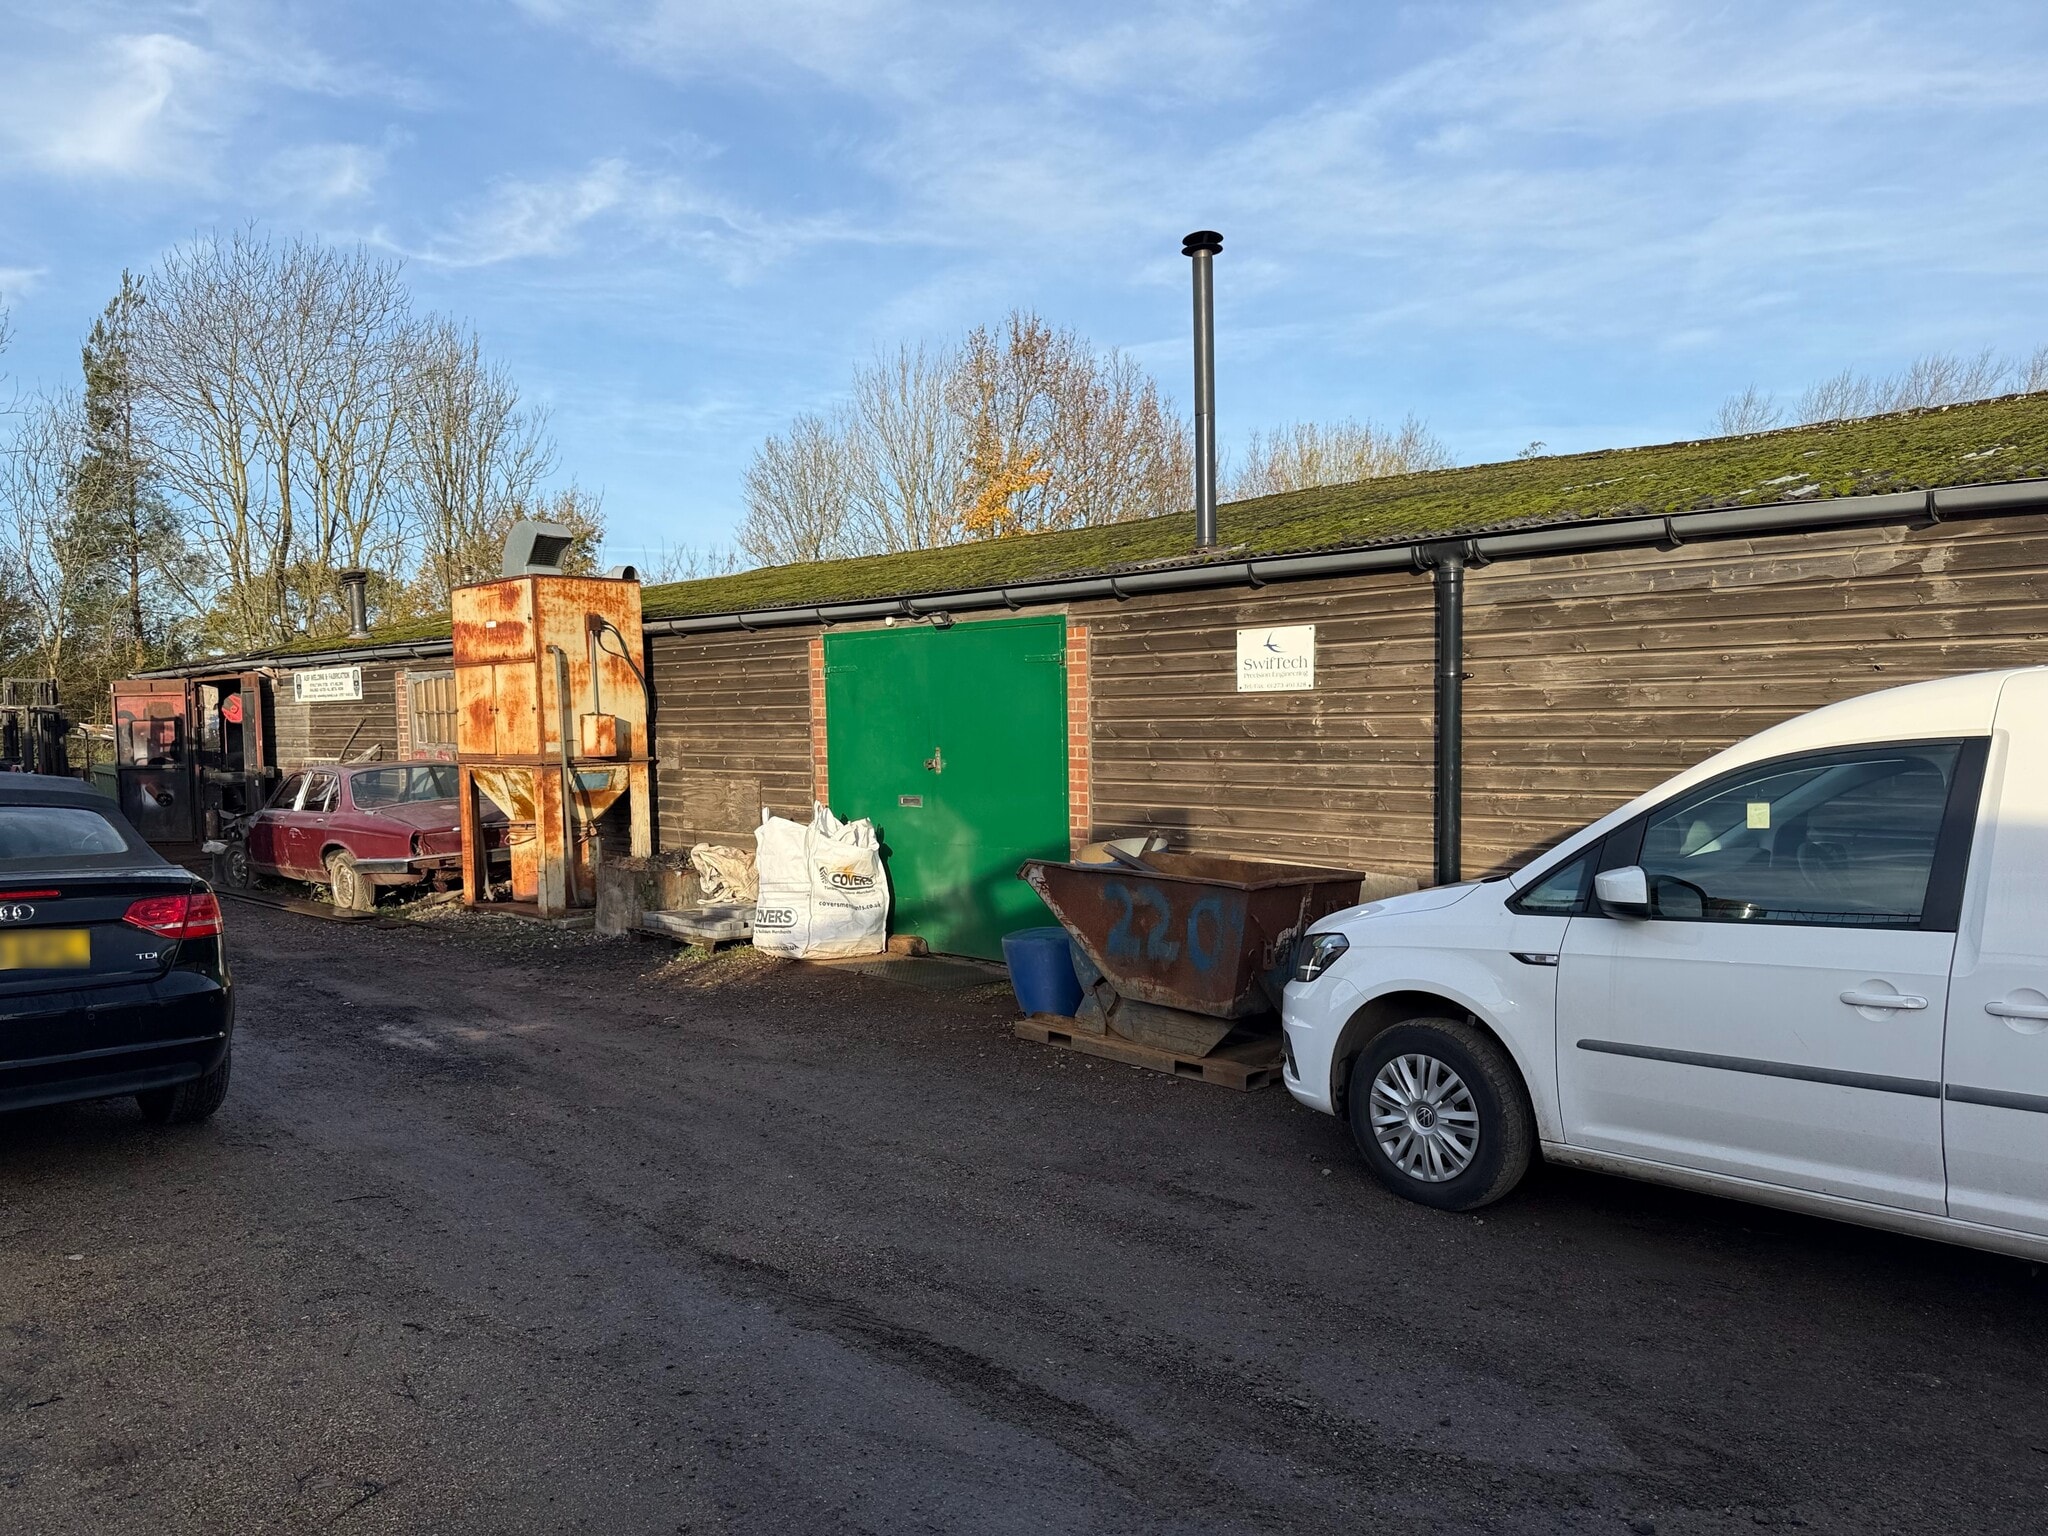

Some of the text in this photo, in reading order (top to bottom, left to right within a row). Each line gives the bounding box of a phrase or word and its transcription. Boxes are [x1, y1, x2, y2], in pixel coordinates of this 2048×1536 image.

[1243, 656, 1308, 670] SwifTech
[832, 873, 874, 886] COVERS
[135, 952, 158, 960] TDI
